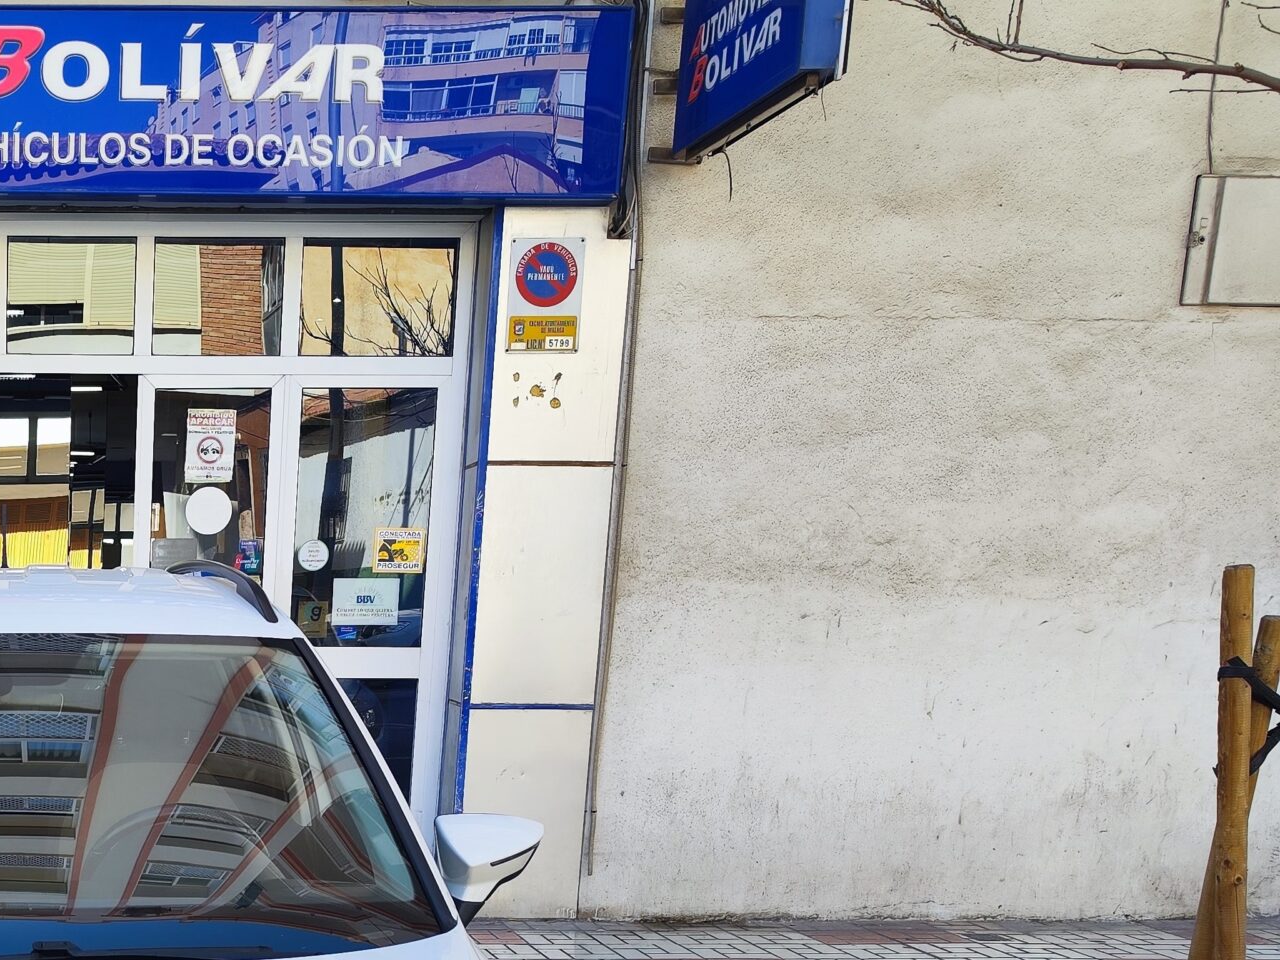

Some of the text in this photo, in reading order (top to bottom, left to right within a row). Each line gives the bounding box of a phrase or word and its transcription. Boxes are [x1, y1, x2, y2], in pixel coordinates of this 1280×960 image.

[687, 7, 782, 104] BOLÍVAR
[164, 132, 214, 166] DE
[226, 124, 405, 168] OCASIÓN
[516, 248, 536, 277] ENTRADA
[540, 243, 550, 251] DE
[539, 265, 555, 273] VADO
[527, 272, 565, 281] PERMANENTE
[189, 418, 234, 426] APARCAR
